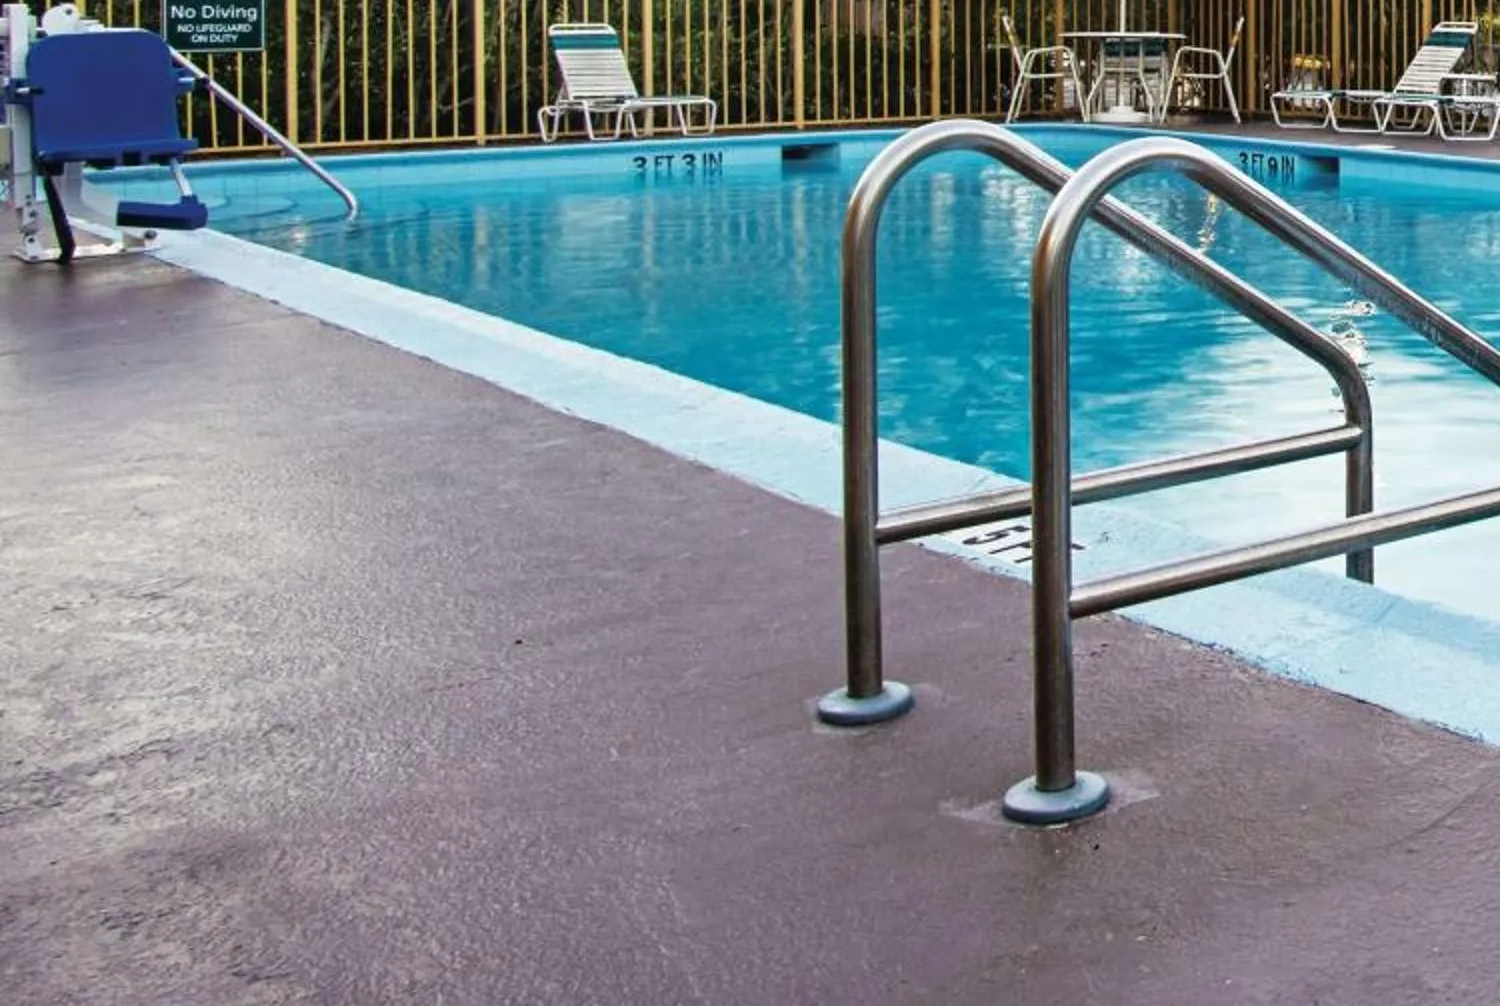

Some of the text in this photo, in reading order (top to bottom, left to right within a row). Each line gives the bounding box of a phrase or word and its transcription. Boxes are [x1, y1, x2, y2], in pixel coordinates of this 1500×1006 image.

[171, 3, 258, 23] No Diving
[177, 24, 253, 33] NO LIFEGUARD
[191, 34, 239, 43] ON DUTY
[654, 154, 675, 172] FT
[702, 151, 723, 173] IN
[962, 524, 1031, 545] 5
